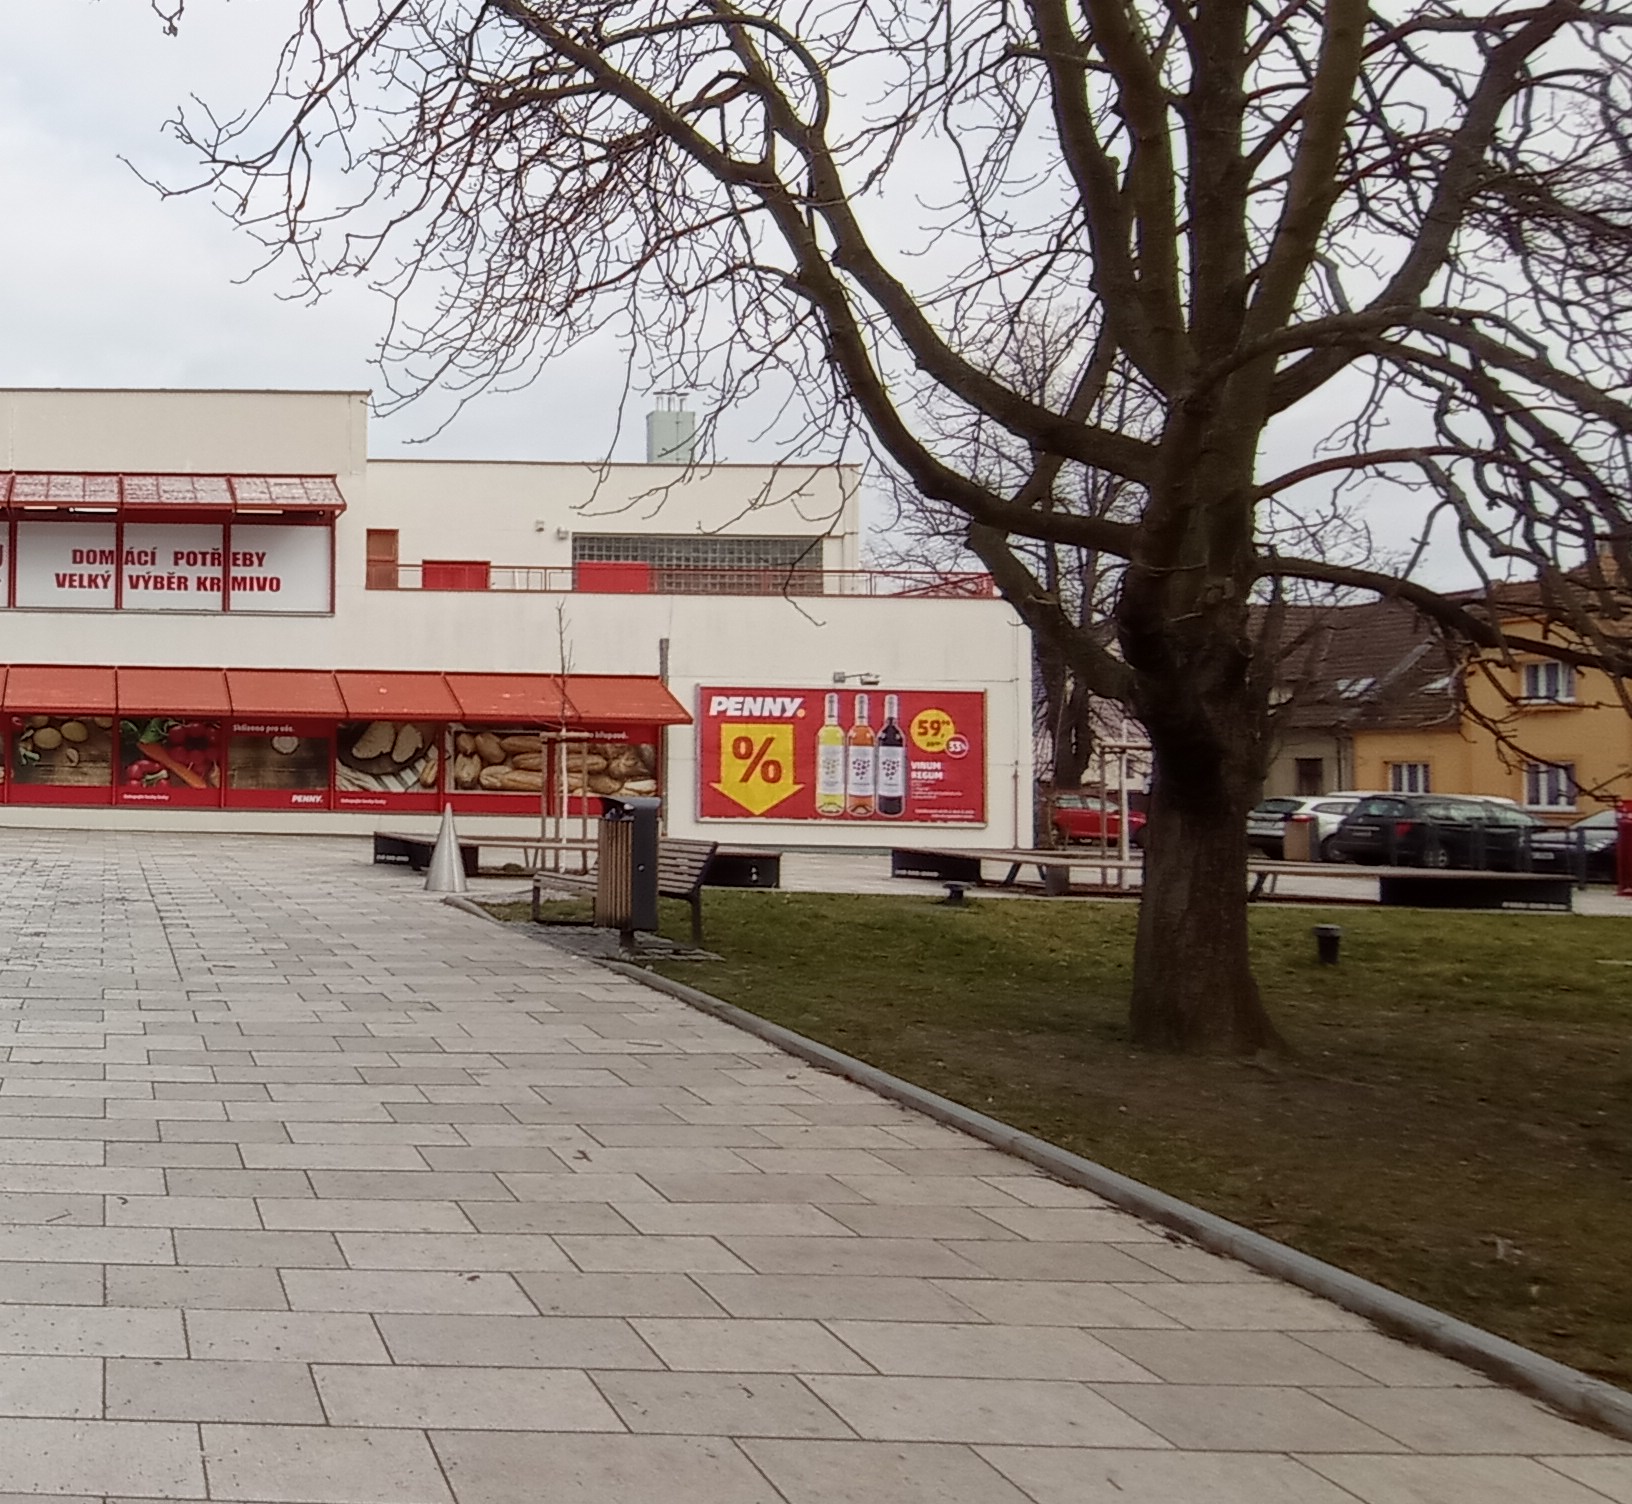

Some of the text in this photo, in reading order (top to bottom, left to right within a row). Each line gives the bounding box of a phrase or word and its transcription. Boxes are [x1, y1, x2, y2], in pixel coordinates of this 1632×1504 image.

[72, 546, 267, 568] DOMÁCÍ POTŘEBY
[55, 570, 281, 593] VELKÝ VÝBĚR KRMIVO
